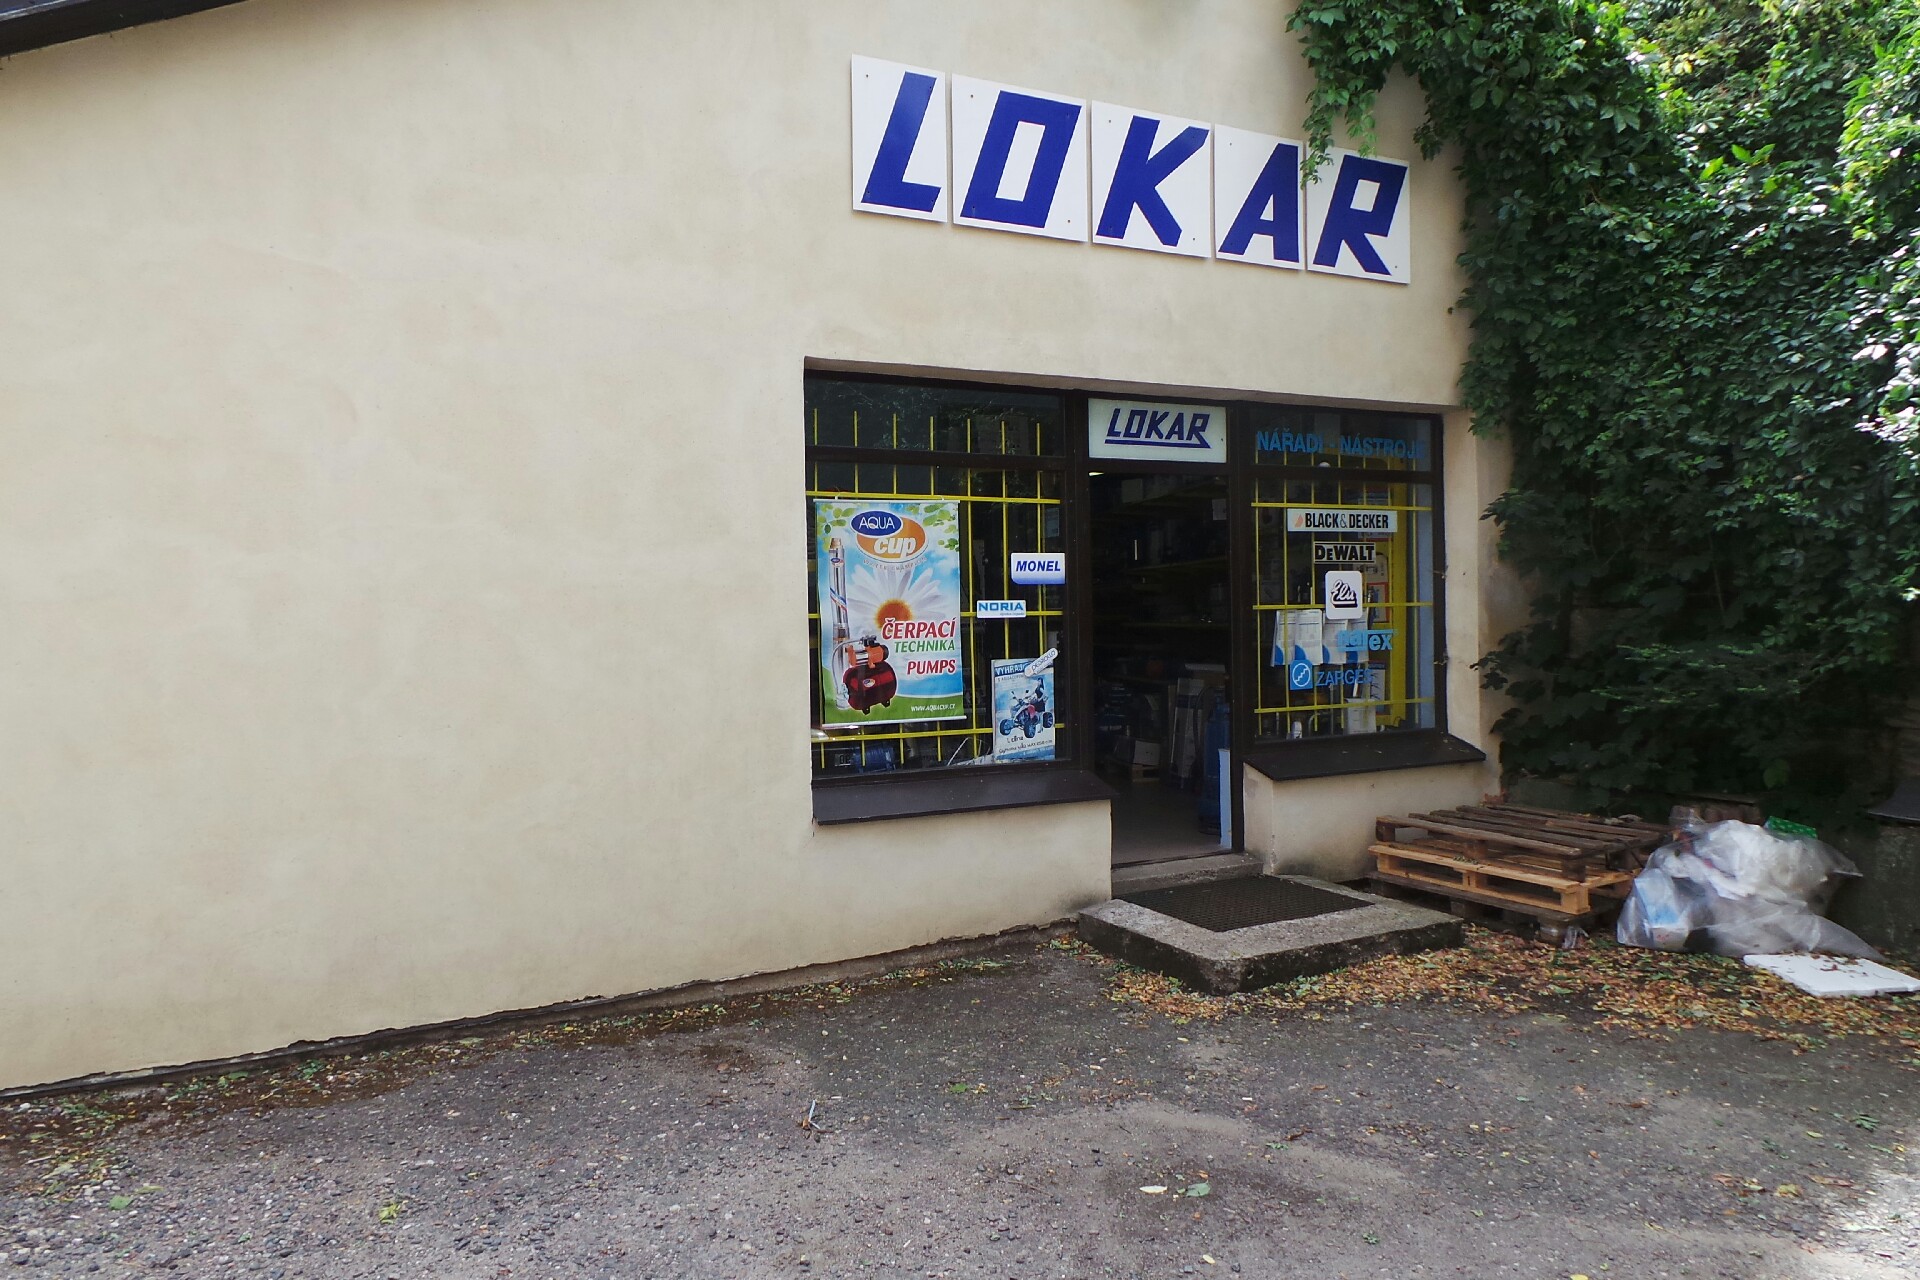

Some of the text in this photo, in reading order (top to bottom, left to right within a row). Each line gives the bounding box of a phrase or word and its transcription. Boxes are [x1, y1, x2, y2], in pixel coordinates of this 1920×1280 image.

[861, 71, 1408, 276] LOKAR
[1105, 408, 1211, 448] LOKAR
[1340, 432, 1426, 459] NÁSTROJE
[859, 516, 895, 530] AQUA
[1304, 512, 1389, 529] BLACK&DECKER
[873, 537, 917, 559] cup
[1015, 560, 1061, 572] MONEL
[1331, 579, 1358, 606] Elu
[978, 602, 1024, 611] NORIA
[882, 616, 957, 640] ČERPACÍ
[894, 639, 956, 653] TECHNIKA
[1337, 630, 1394, 651] narex
[907, 659, 956, 675] PUMPS
[1316, 669, 1374, 687] ZARGES
